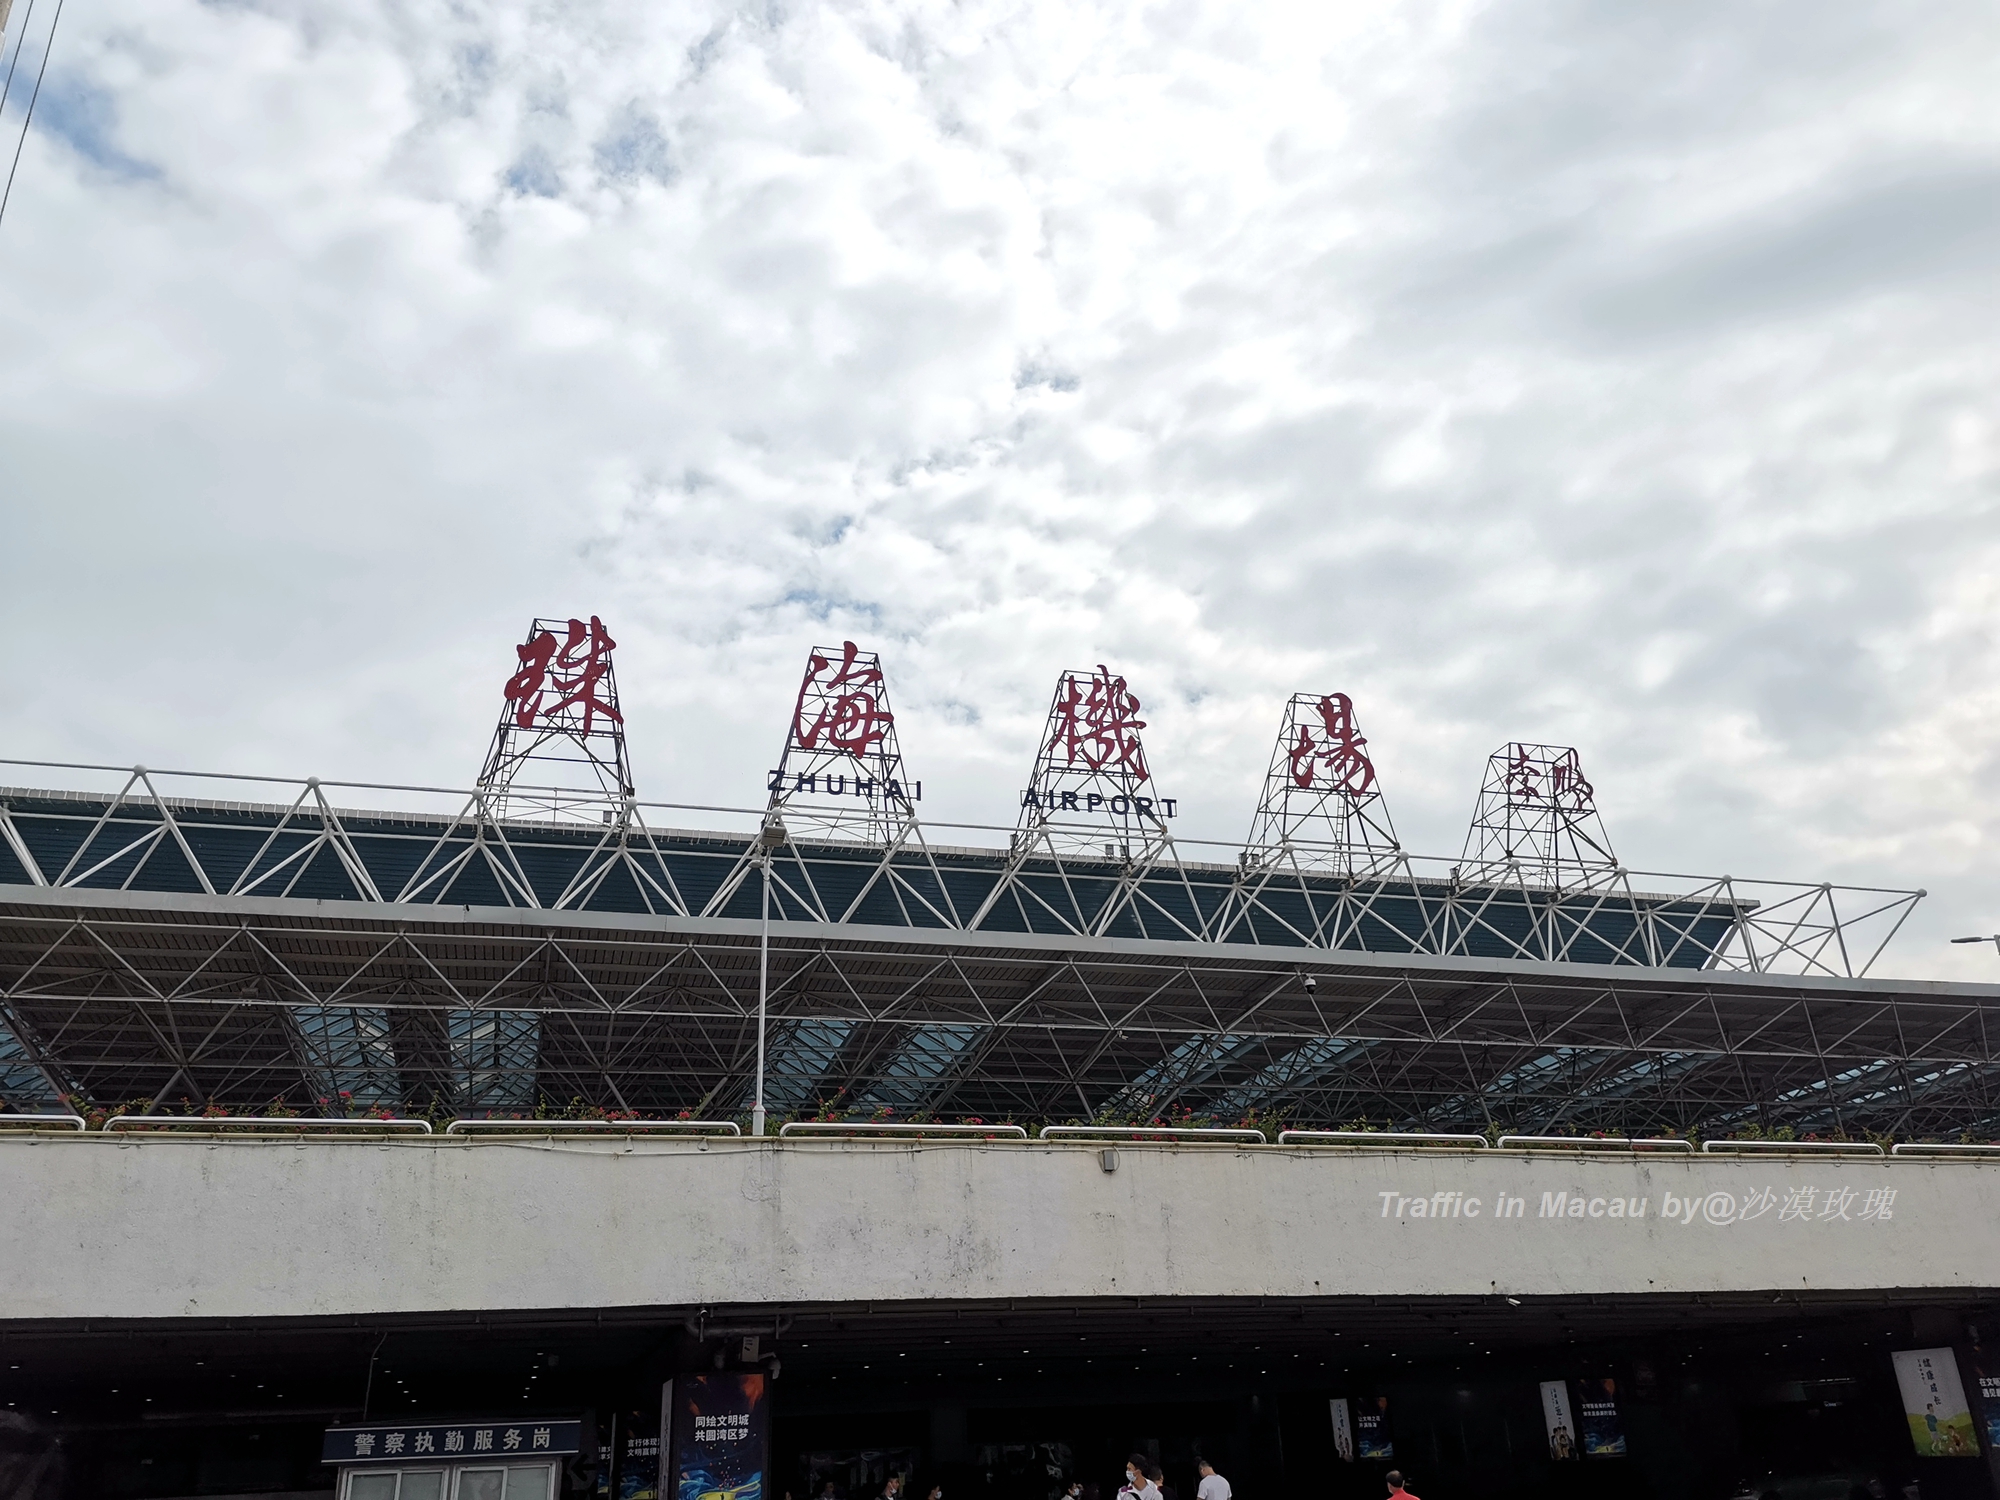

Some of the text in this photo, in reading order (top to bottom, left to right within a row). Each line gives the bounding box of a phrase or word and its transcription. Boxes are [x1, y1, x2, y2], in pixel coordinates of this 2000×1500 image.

[767, 769, 1178, 818] ZHUHAI AIRPORT
[694, 1413, 750, 1429] 同绘文明城
[354, 1426, 551, 1456] 警察执勤服务岗
[694, 1427, 749, 1442] 共圆湾区梦
[627, 1437, 660, 1448] 言行体现
[626, 1447, 660, 1458] 文明赢得
